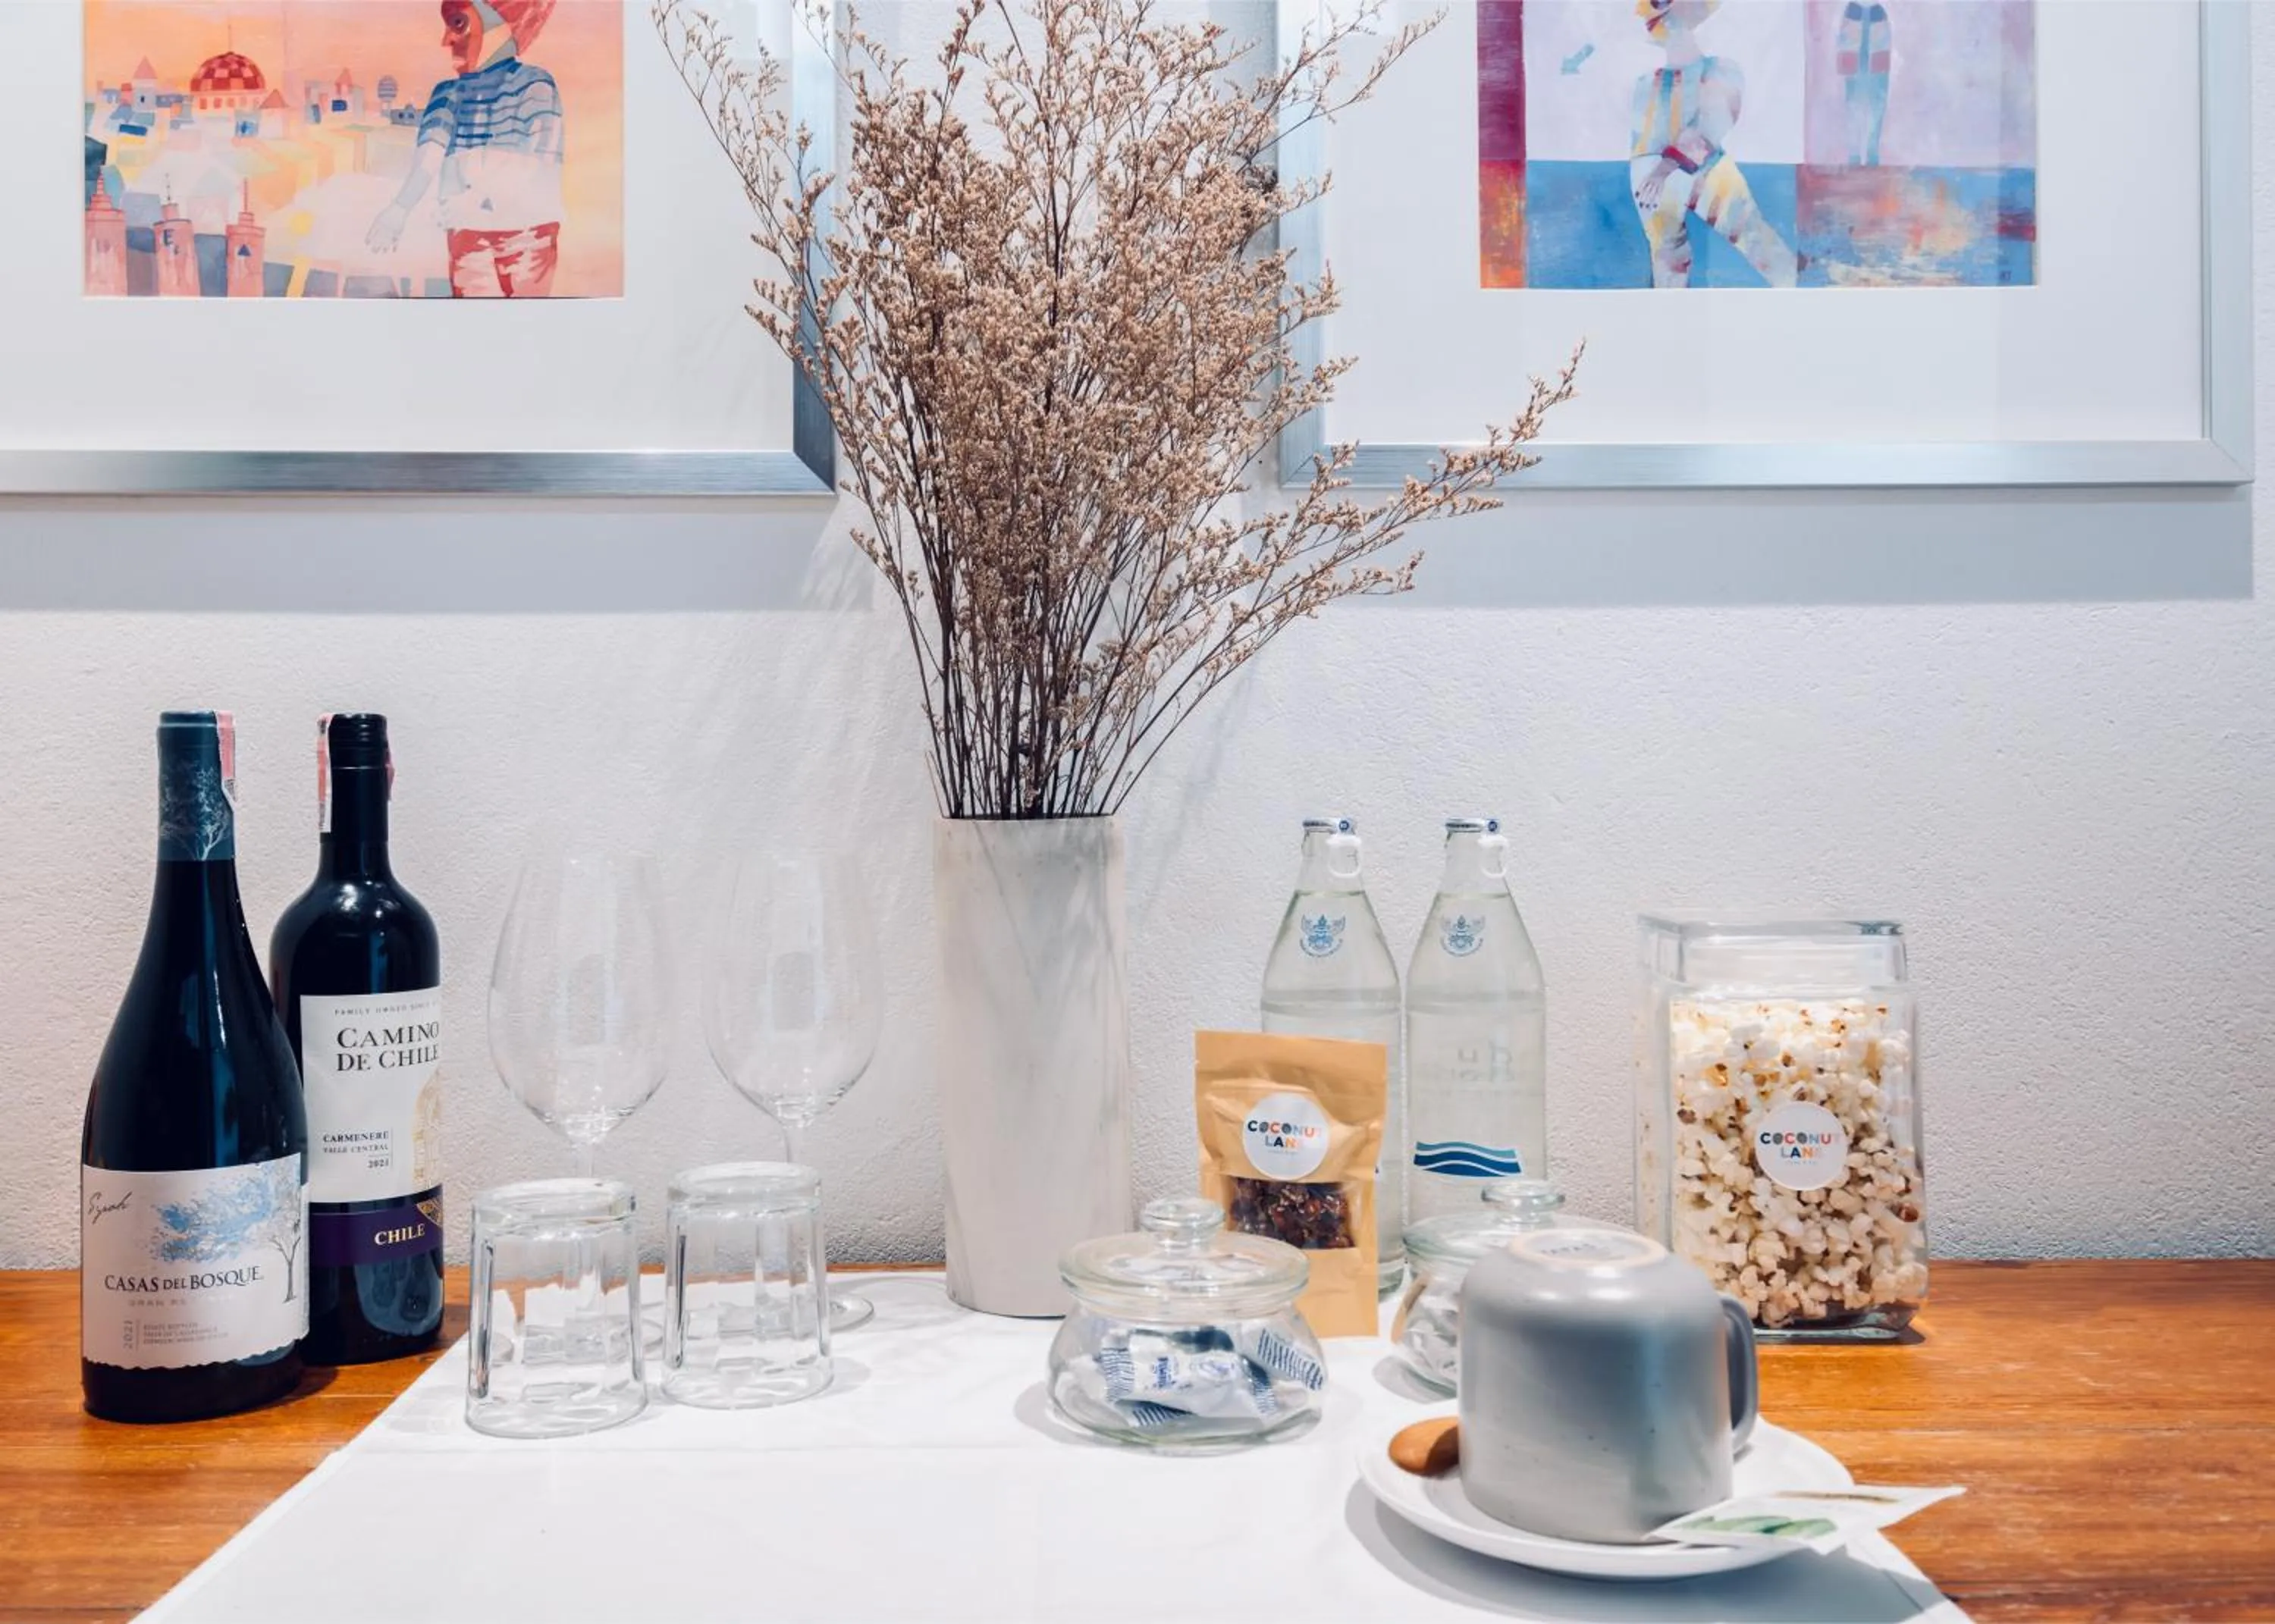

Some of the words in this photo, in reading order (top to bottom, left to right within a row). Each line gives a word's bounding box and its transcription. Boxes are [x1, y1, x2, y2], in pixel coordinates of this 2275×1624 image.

[336, 1020, 440, 1049] CAMINO
[336, 1052, 372, 1072] DE
[378, 1043, 440, 1069] CHILE
[322, 1130, 389, 1143] CARMENERE
[350, 1144, 389, 1153] CENTRAL
[1781, 1146, 1822, 1158] LAN
[88, 1191, 133, 1224] Syrah
[374, 1222, 426, 1246] CHILE
[104, 1274, 158, 1293] CASAS
[162, 1278, 187, 1290] DEL
[190, 1265, 262, 1290] BOSQUE
